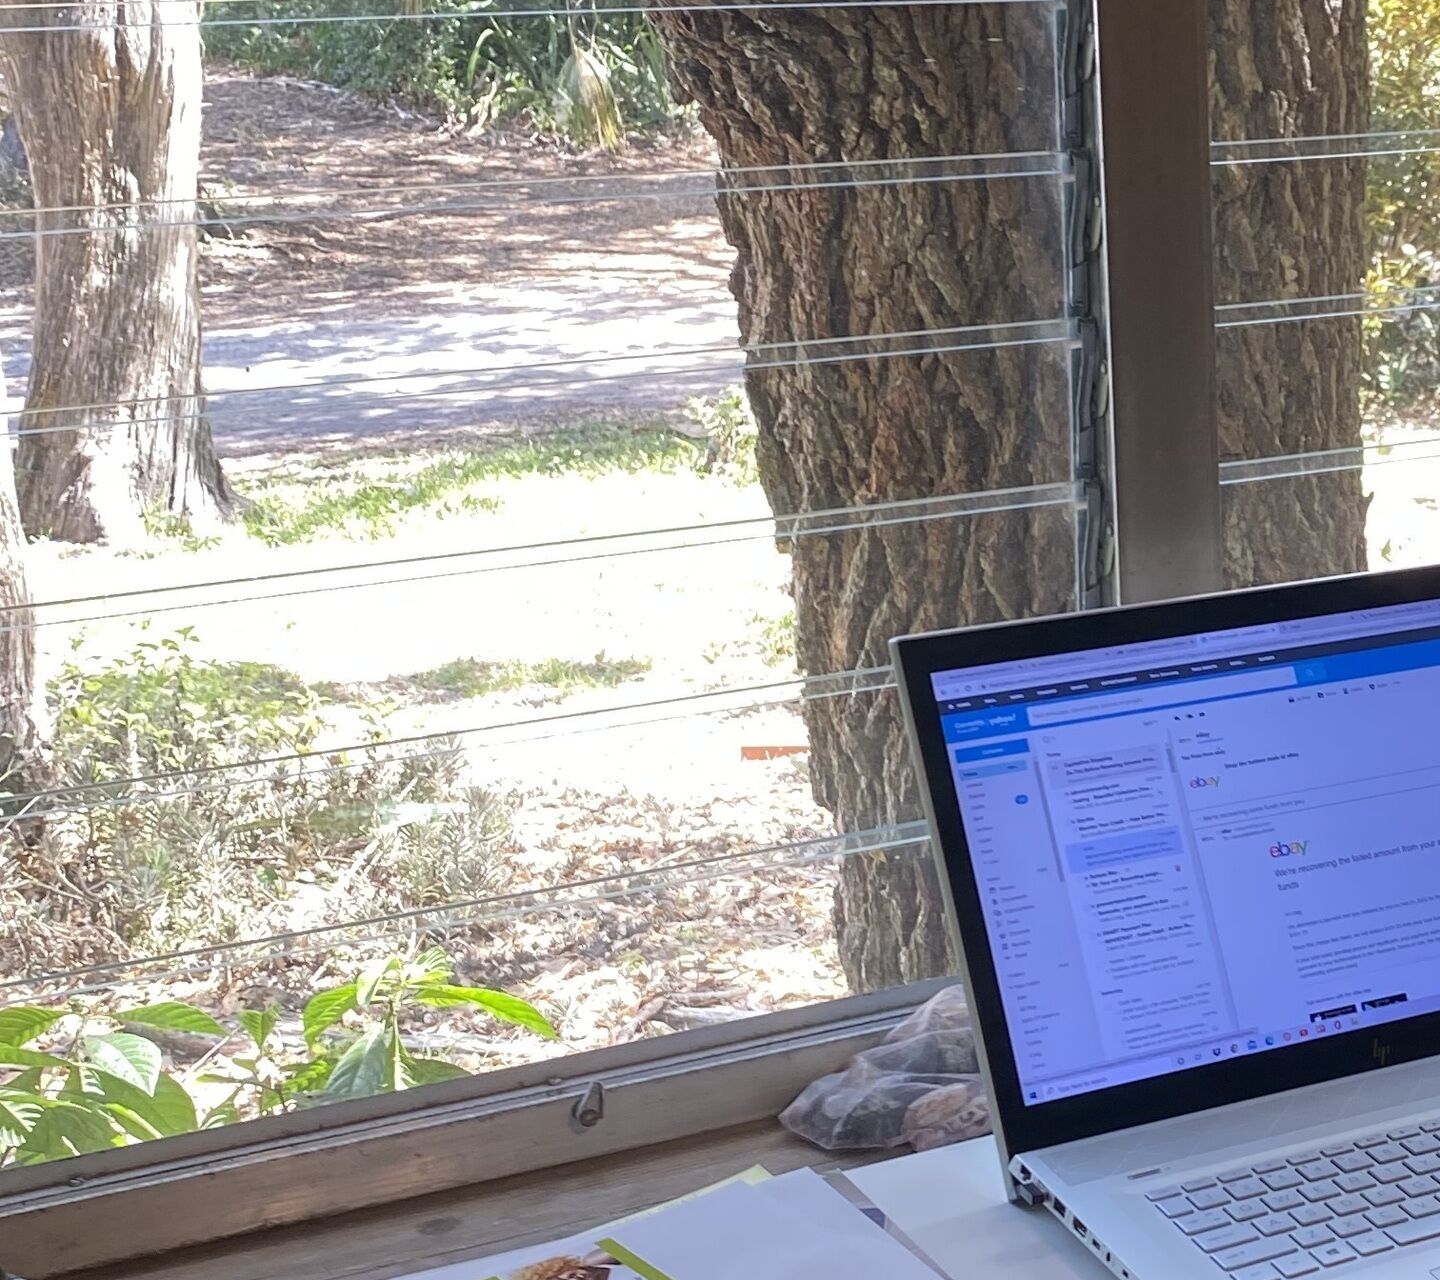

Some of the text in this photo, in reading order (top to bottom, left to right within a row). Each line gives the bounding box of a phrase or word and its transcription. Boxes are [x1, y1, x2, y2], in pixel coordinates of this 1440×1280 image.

[1189, 776, 1219, 788] ebay
[1269, 841, 1306, 857] ebay
[1298, 859, 1337, 872] recovering
[1338, 857, 1350, 865] the
[1373, 847, 1400, 858] amount
[1401, 844, 1418, 852] from
[1419, 840, 1435, 850] your
[1277, 881, 1299, 890] funds
